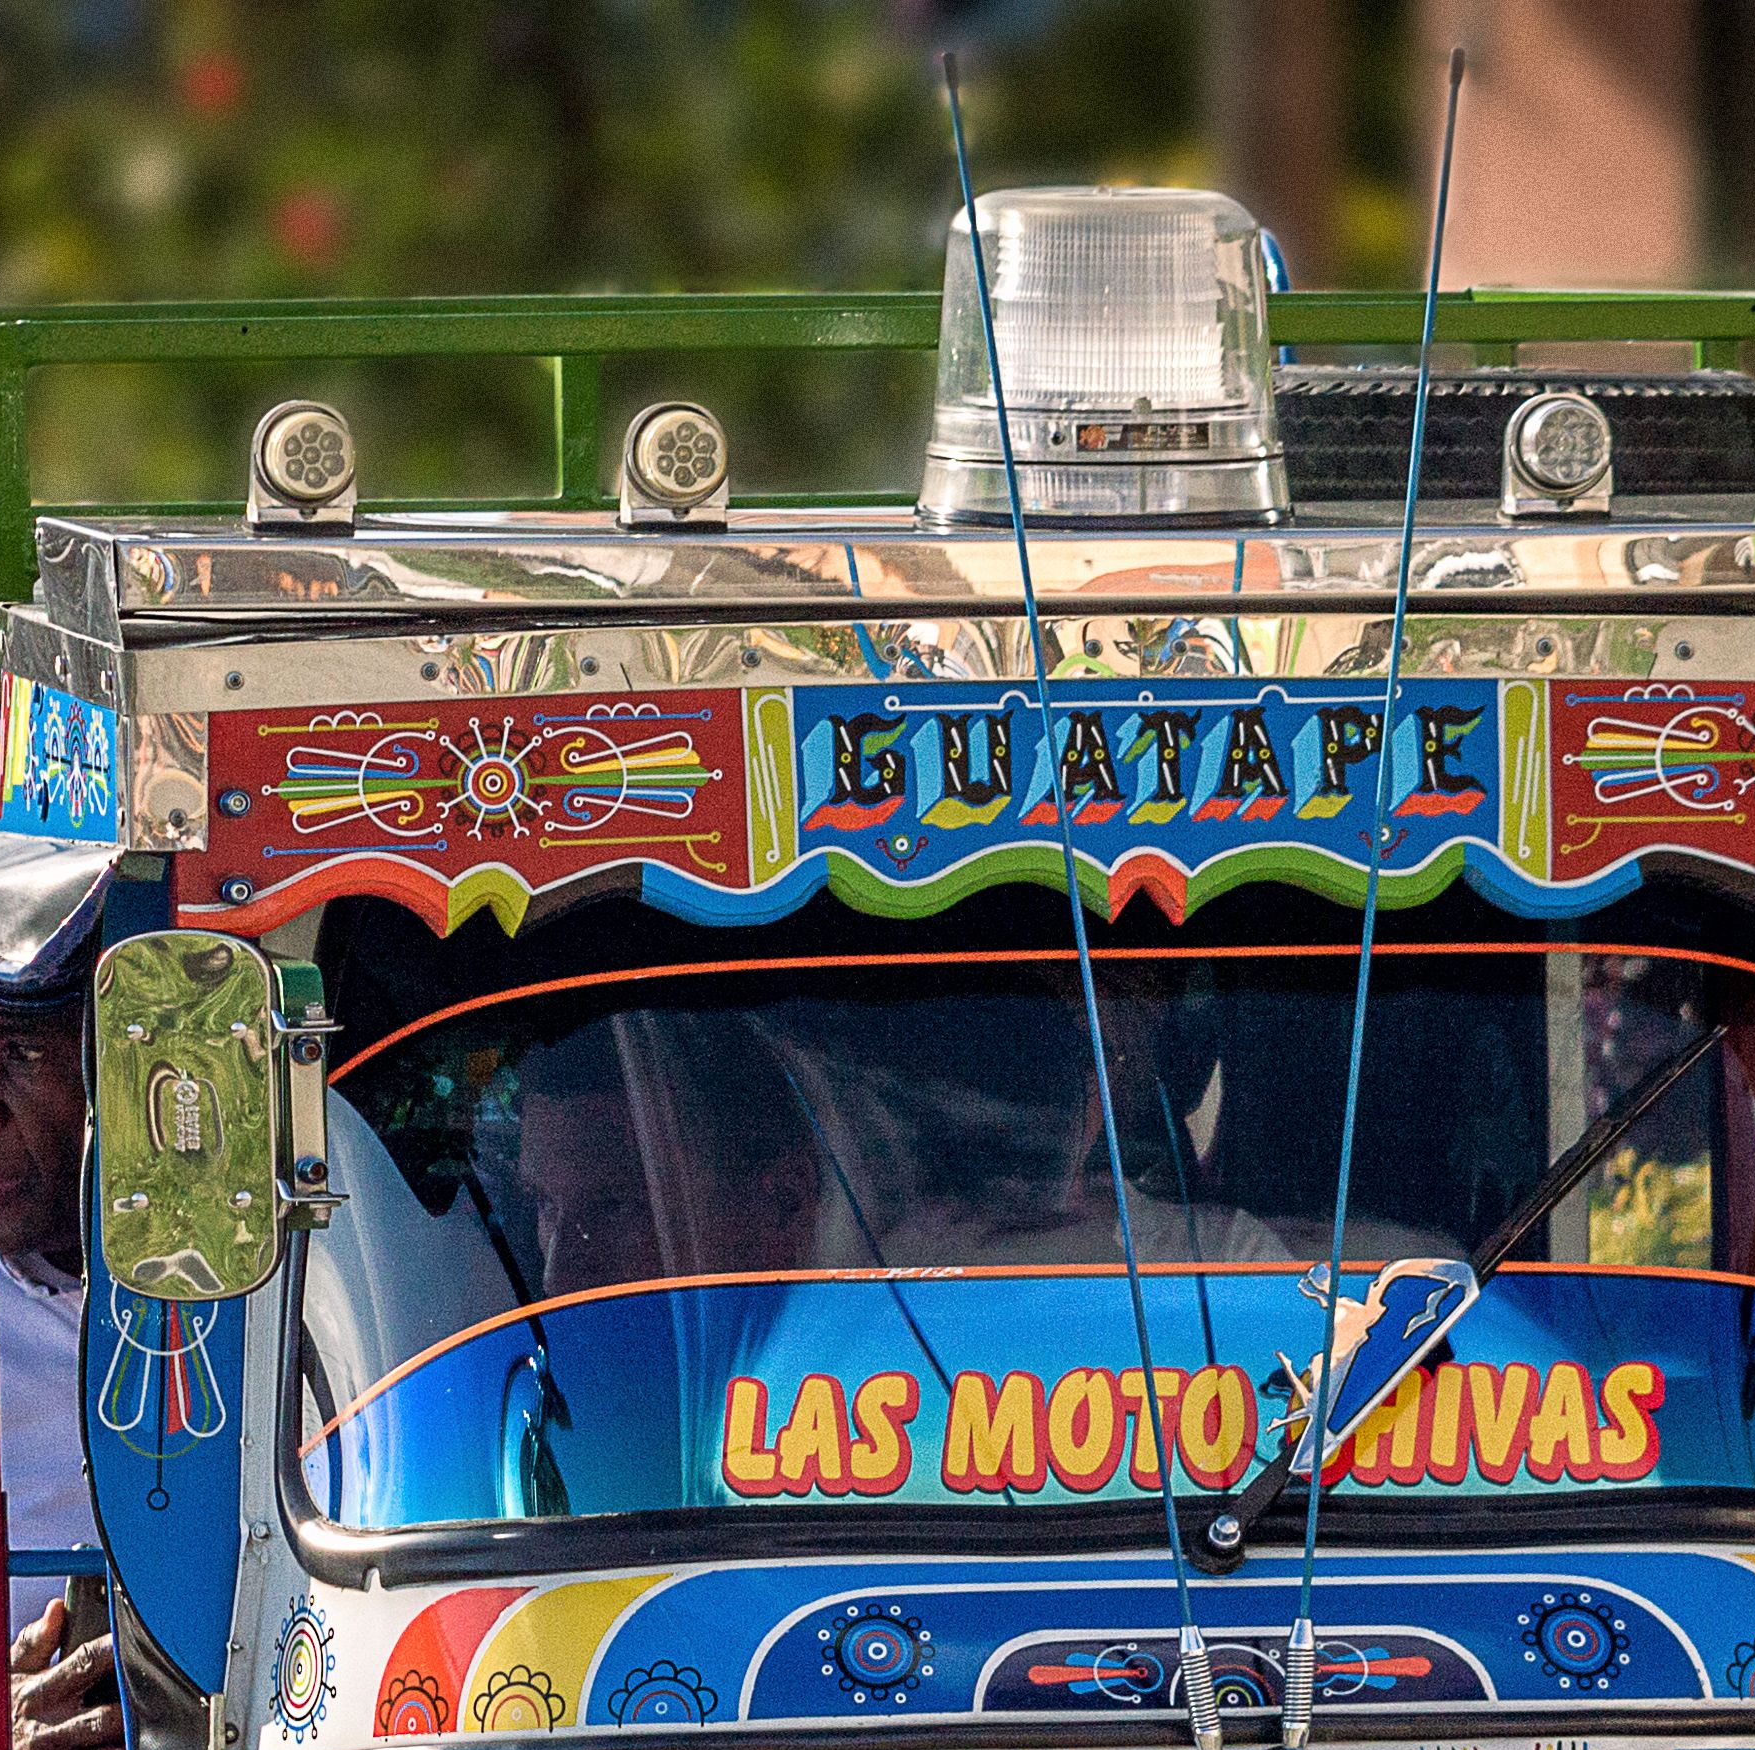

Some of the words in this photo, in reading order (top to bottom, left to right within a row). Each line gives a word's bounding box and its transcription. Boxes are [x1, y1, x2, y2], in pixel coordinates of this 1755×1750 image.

[799, 704, 1488, 830] GUATAPE
[722, 1371, 920, 1496] LAS
[942, 1362, 1259, 1493] MOTO
[1286, 1360, 1667, 1488] HIVAS
